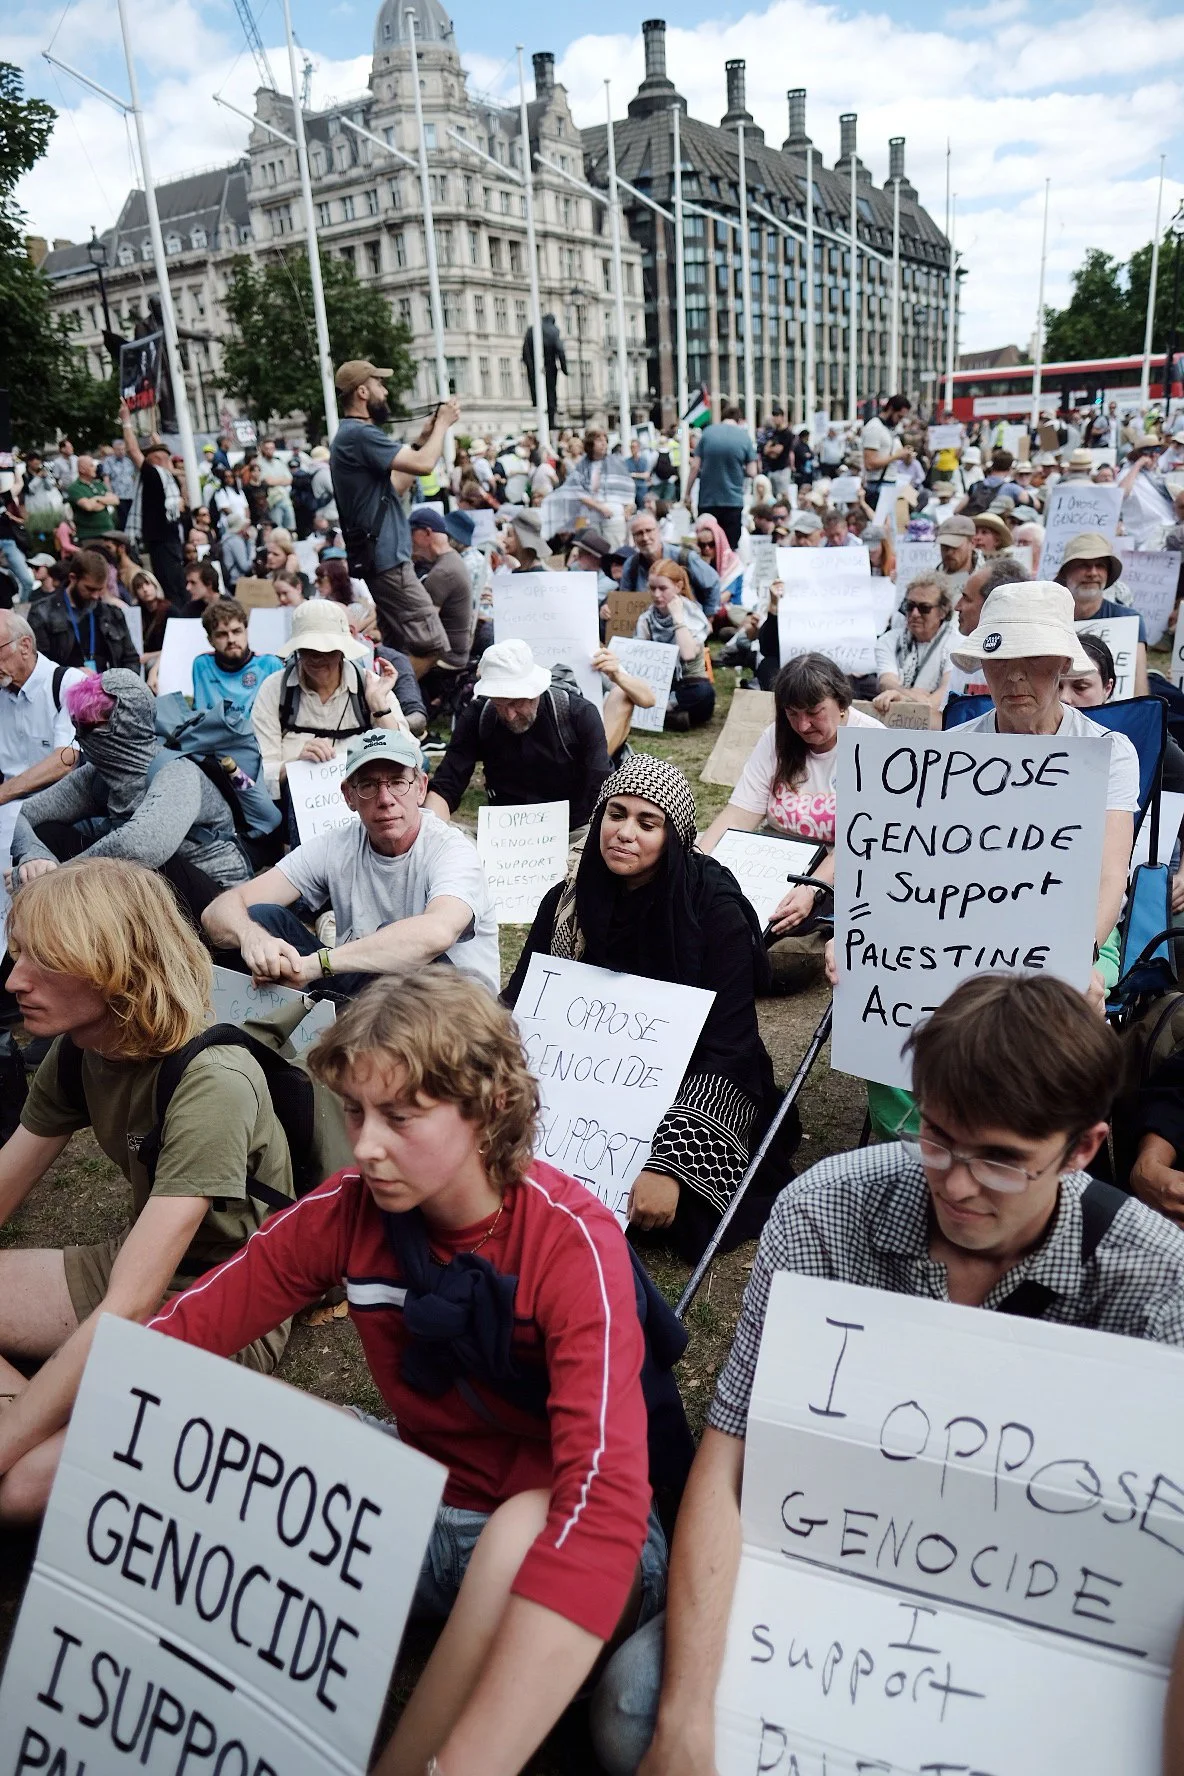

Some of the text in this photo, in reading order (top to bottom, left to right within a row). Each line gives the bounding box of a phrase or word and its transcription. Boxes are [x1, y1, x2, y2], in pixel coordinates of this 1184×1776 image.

[363, 741, 387, 750] adidas
[854, 743, 1070, 808] I OPPOSE
[490, 835, 558, 849] GENOCIDE
[499, 810, 551, 829] OPPOSE
[846, 811, 1082, 861] GENOCIDE
[496, 856, 556, 870] SUPPORT
[744, 842, 805, 863] OPPOSE
[487, 873, 559, 888] PALESTINE
[845, 928, 1051, 971] PALESTINE
[523, 969, 670, 1043] I OPPOSE
[808, 1316, 1184, 1556] I OPPOSE
[112, 1387, 382, 1592] I OPPOSE
[780, 1490, 1124, 1625] GENOCIDE
[86, 1489, 360, 1713] GENOCIDE
[888, 1602, 942, 1655] I
[36, 1625, 83, 1714] I
